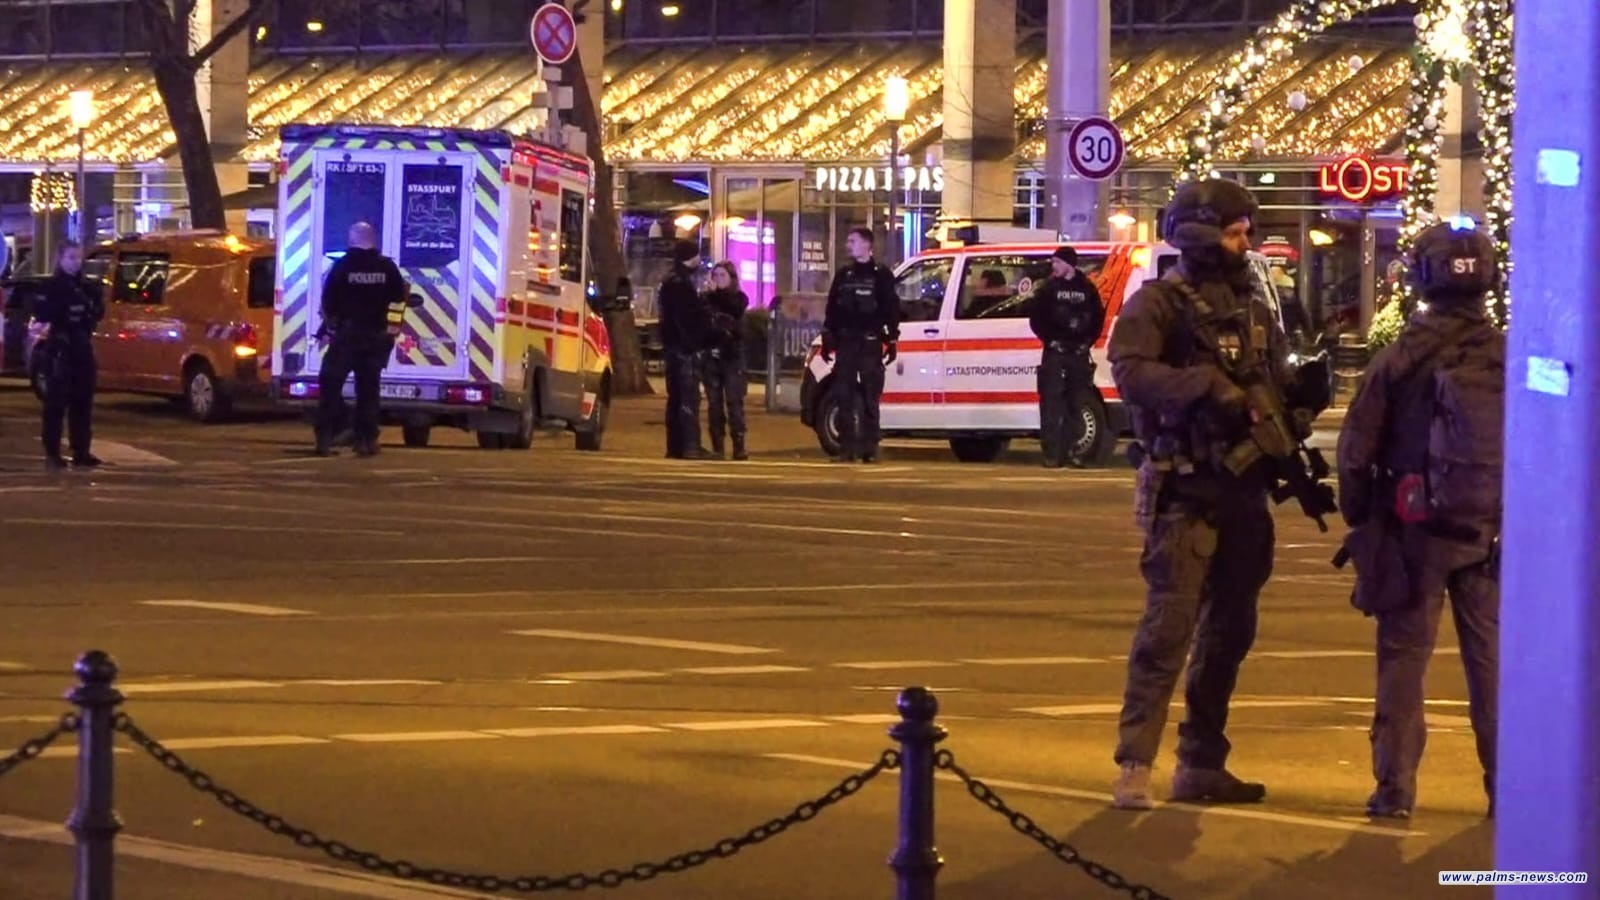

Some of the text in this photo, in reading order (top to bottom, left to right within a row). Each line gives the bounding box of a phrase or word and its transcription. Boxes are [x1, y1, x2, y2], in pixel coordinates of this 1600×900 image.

[1081, 136, 1112, 163] 30
[816, 166, 876, 191] PIZZA
[904, 166, 944, 191] PAS
[408, 184, 456, 193] STASSFURT
[1454, 258, 1476, 273] ST
[348, 272, 386, 284] POLIZEI
